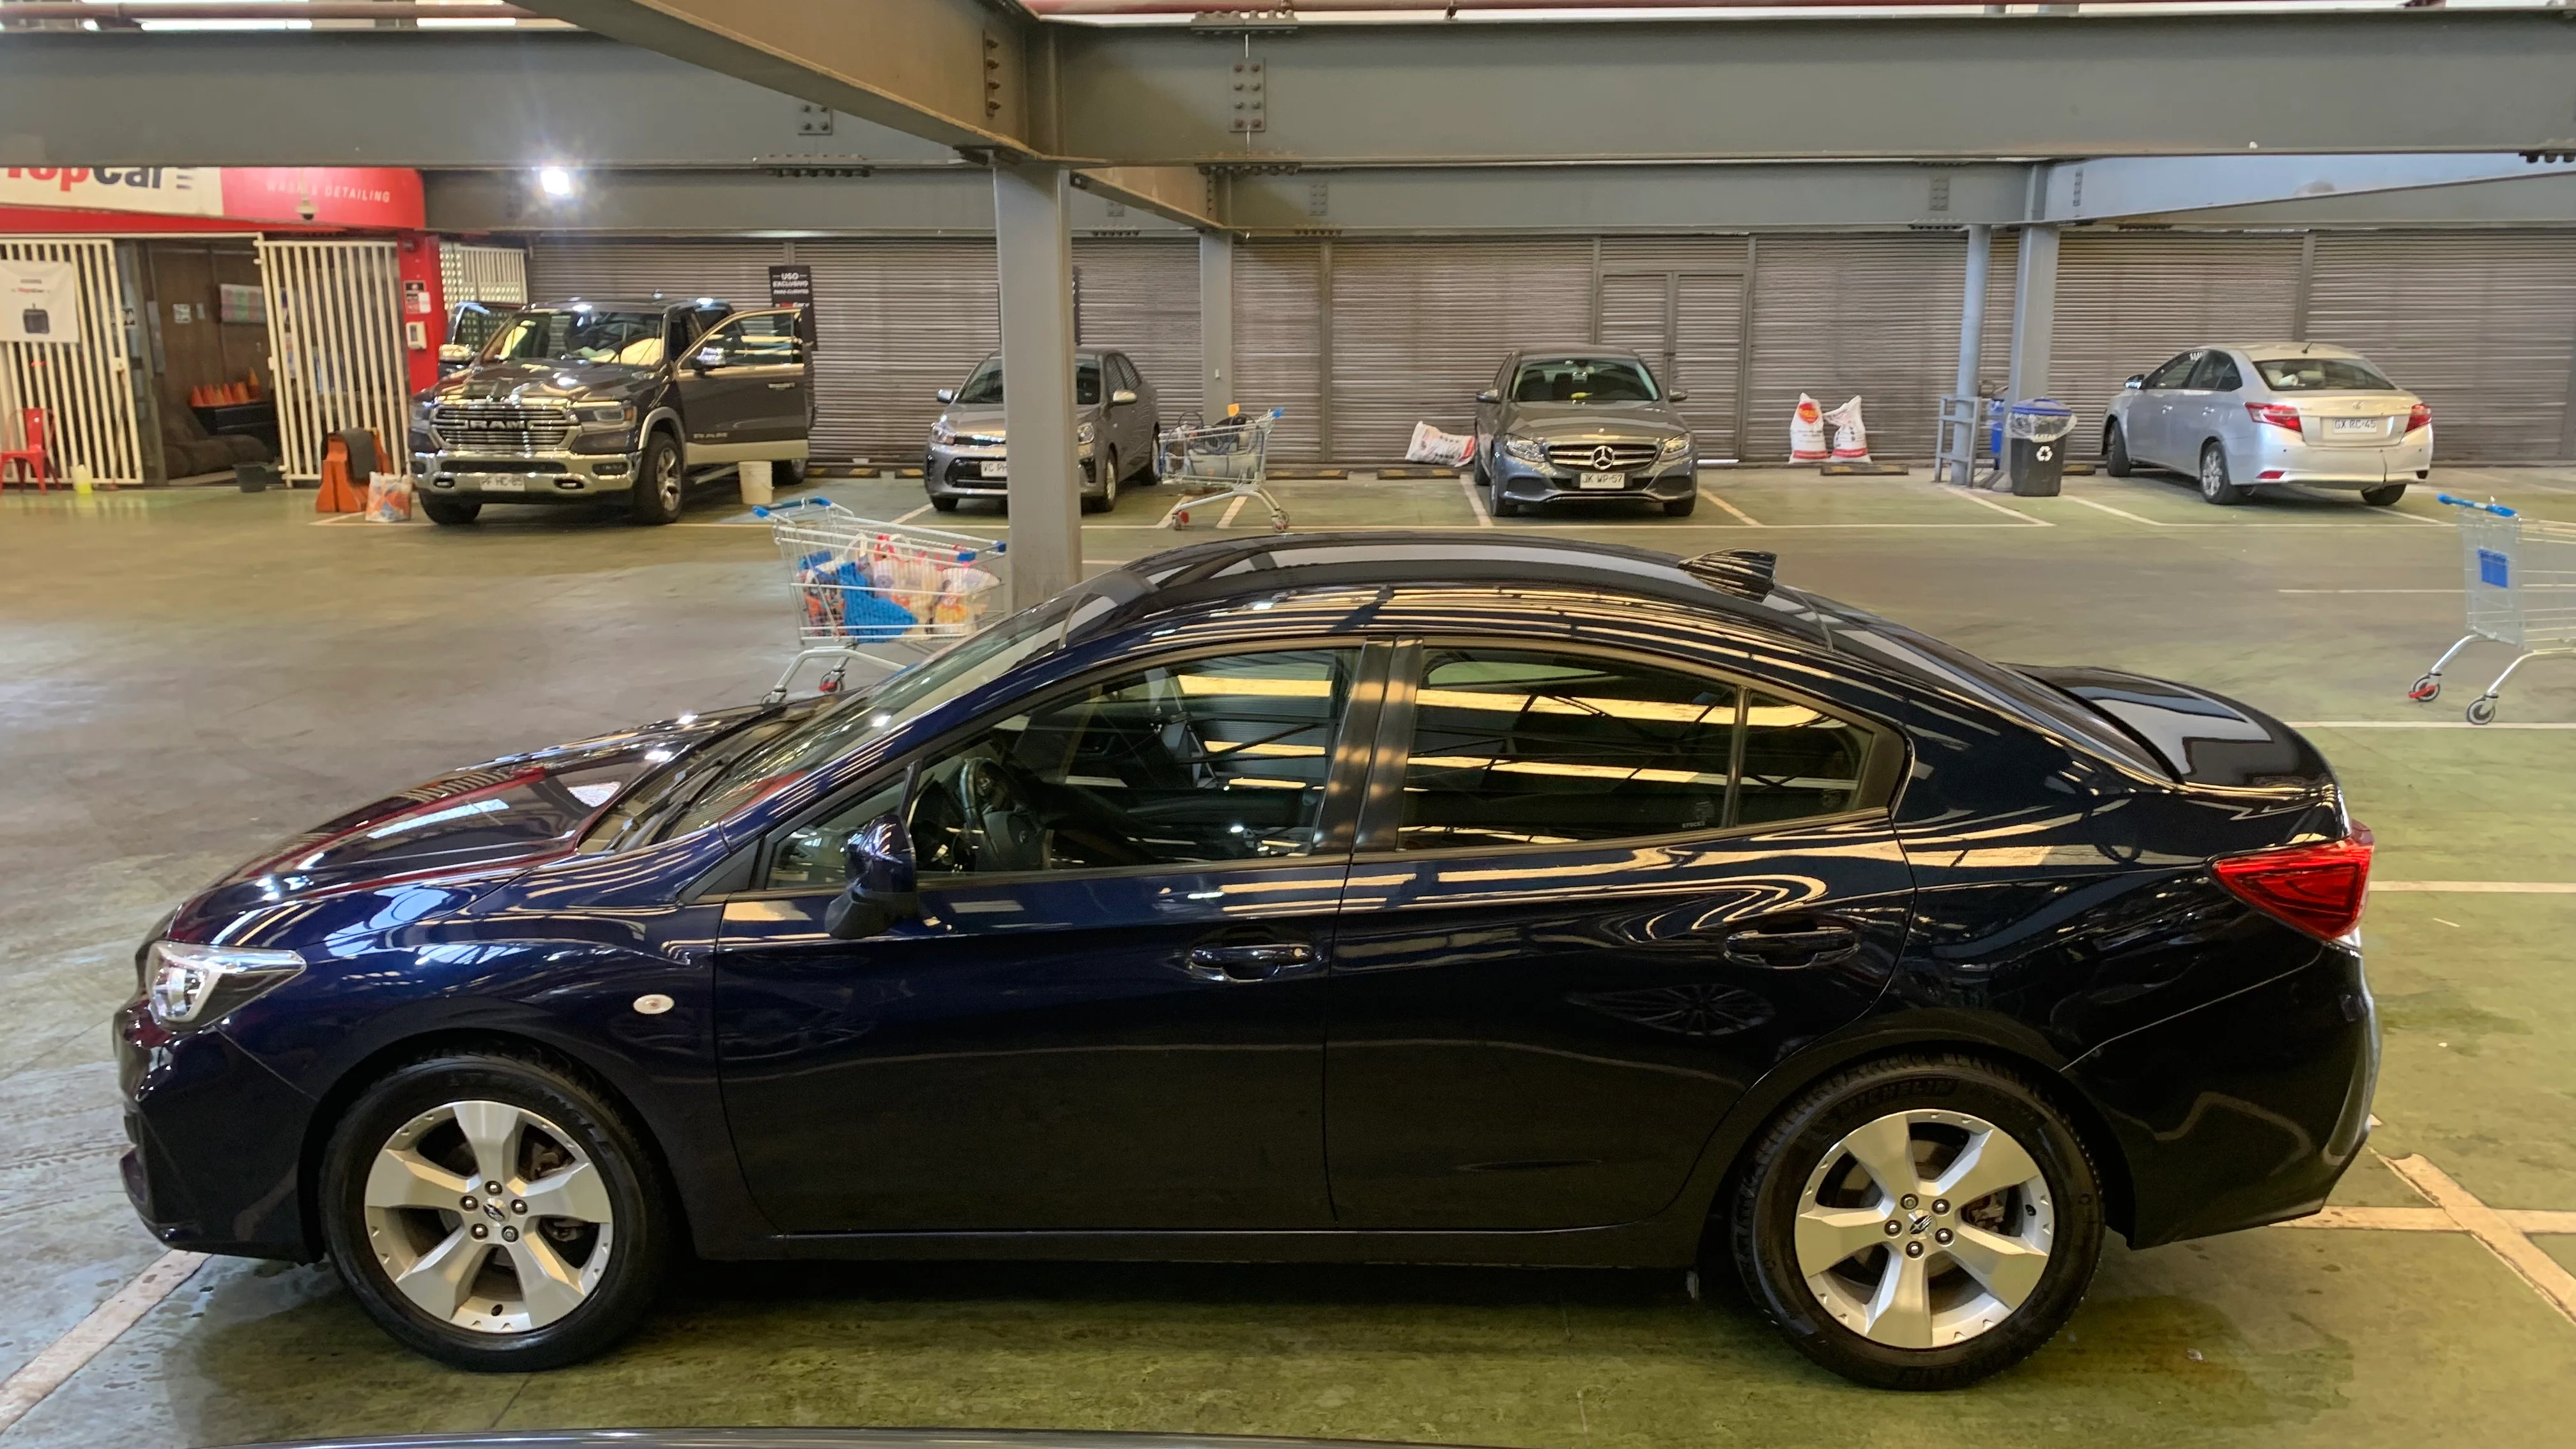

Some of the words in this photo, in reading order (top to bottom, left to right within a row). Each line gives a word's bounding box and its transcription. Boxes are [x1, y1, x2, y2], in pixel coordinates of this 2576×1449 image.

[325, 185, 391, 203] DETAILING
[781, 272, 799, 280] USO
[470, 420, 525, 429] RAM
